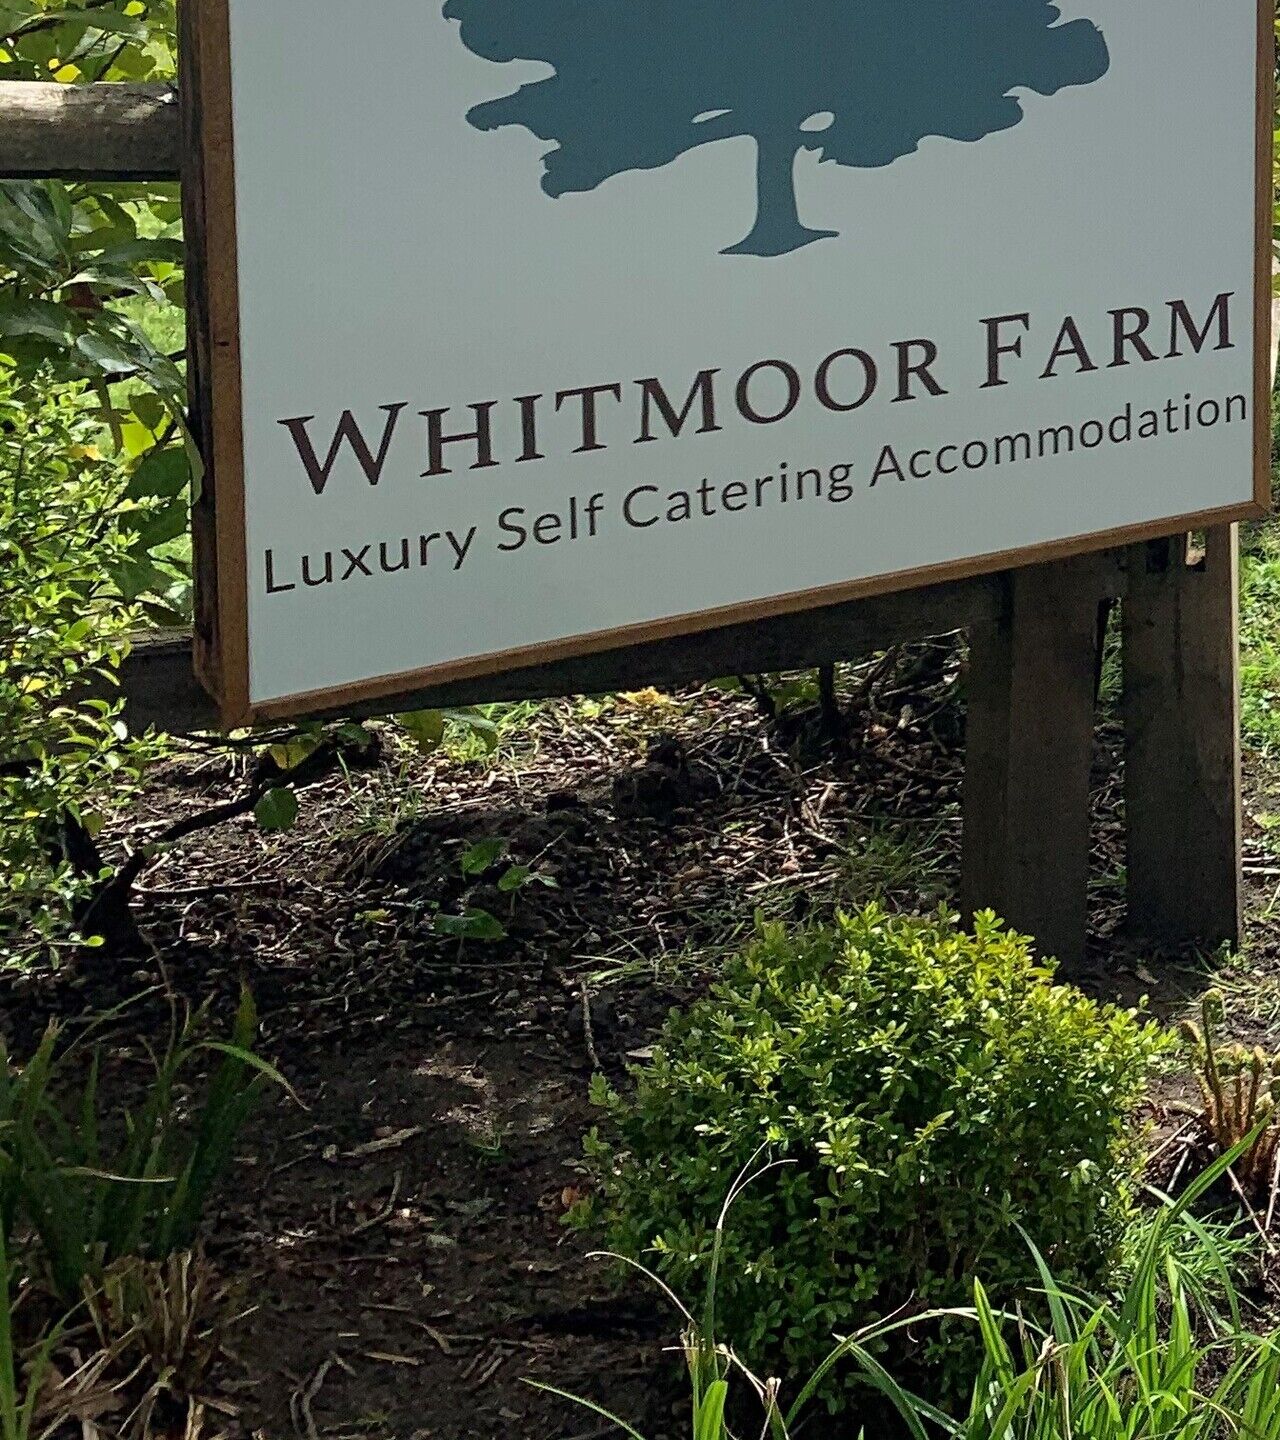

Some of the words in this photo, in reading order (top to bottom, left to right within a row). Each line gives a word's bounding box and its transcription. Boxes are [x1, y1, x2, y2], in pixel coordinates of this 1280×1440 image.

[264, 525, 477, 594] Luxury
[496, 492, 605, 551] Self
[622, 461, 855, 528] Catering
[868, 392, 1248, 488] Accommodation
[277, 338, 949, 496] WHITMOOR
[978, 291, 1236, 389] FARM
